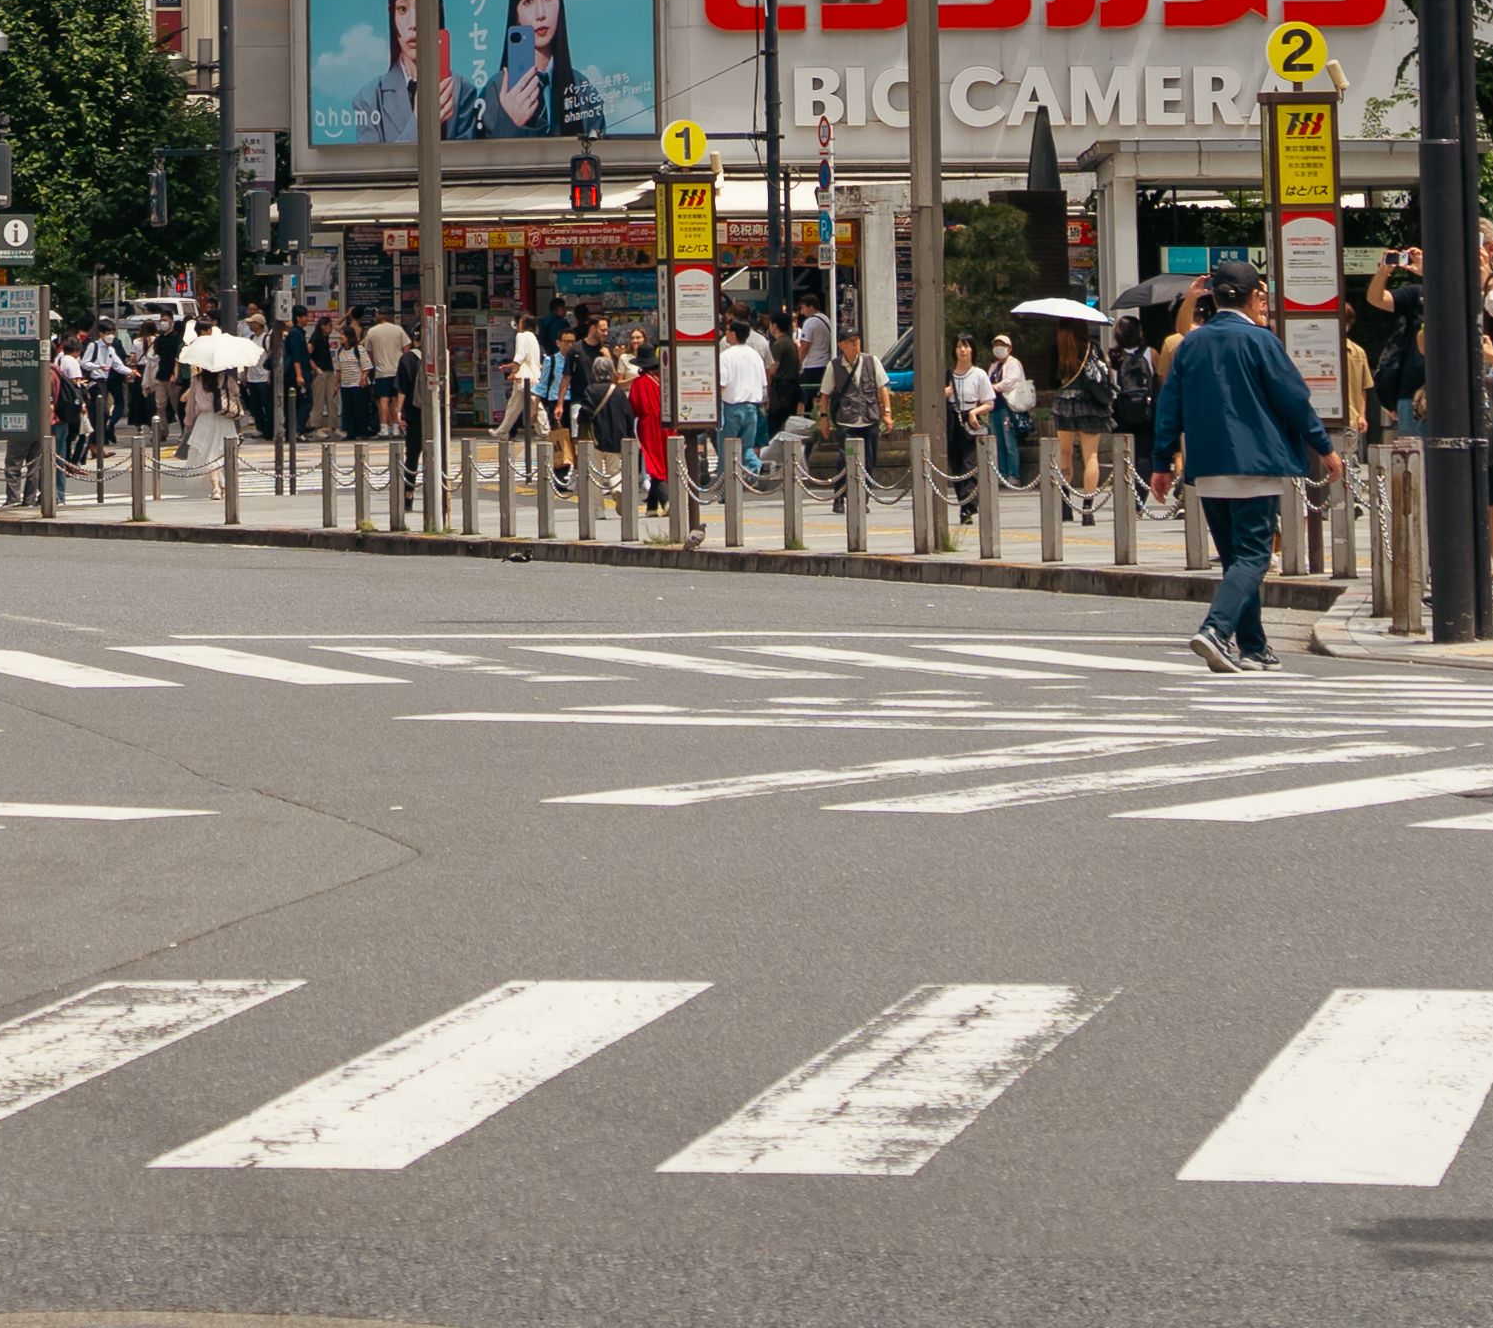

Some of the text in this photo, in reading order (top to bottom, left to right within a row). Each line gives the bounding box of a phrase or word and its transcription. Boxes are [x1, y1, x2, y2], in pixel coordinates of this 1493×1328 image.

[1281, 28, 1315, 74] 2
[793, 66, 909, 128] BIC
[315, 108, 382, 129] ahamo
[676, 127, 693, 161] 1
[1285, 185, 1329, 197] はとバス
[443, 238, 465, 247] Store
[677, 244, 709, 253] はとバス
